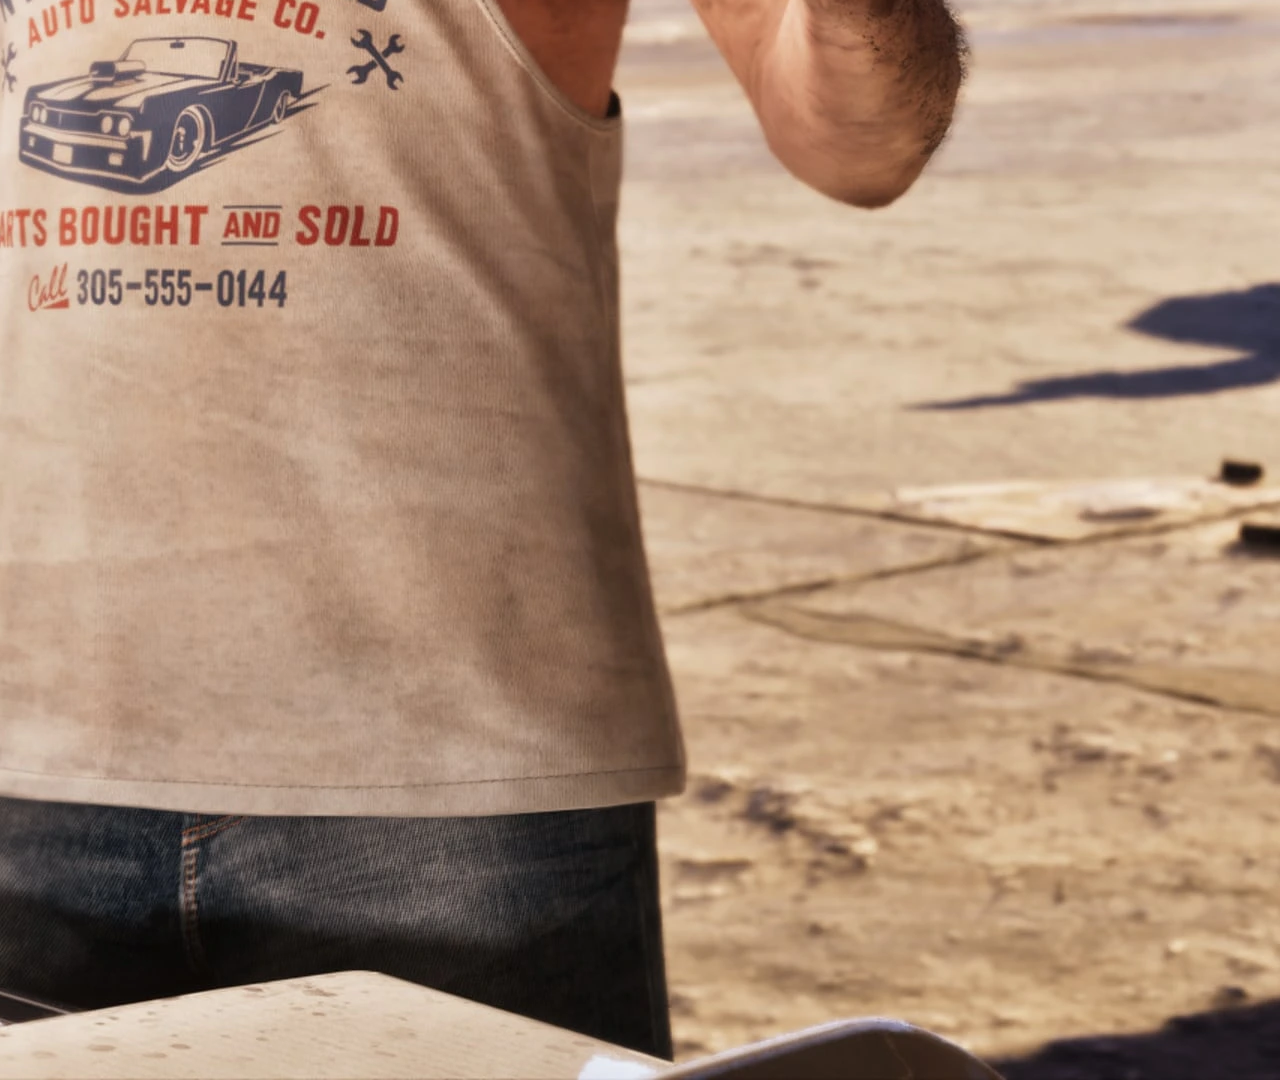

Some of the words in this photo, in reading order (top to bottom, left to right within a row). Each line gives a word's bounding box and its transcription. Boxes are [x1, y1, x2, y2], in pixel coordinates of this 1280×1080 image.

[58, 204, 209, 247] BOUGHT
[222, 210, 281, 240] AND
[295, 204, 399, 247] SOLD
[28, 262, 69, 313] Call
[76, 268, 288, 308] 305-555-0144
